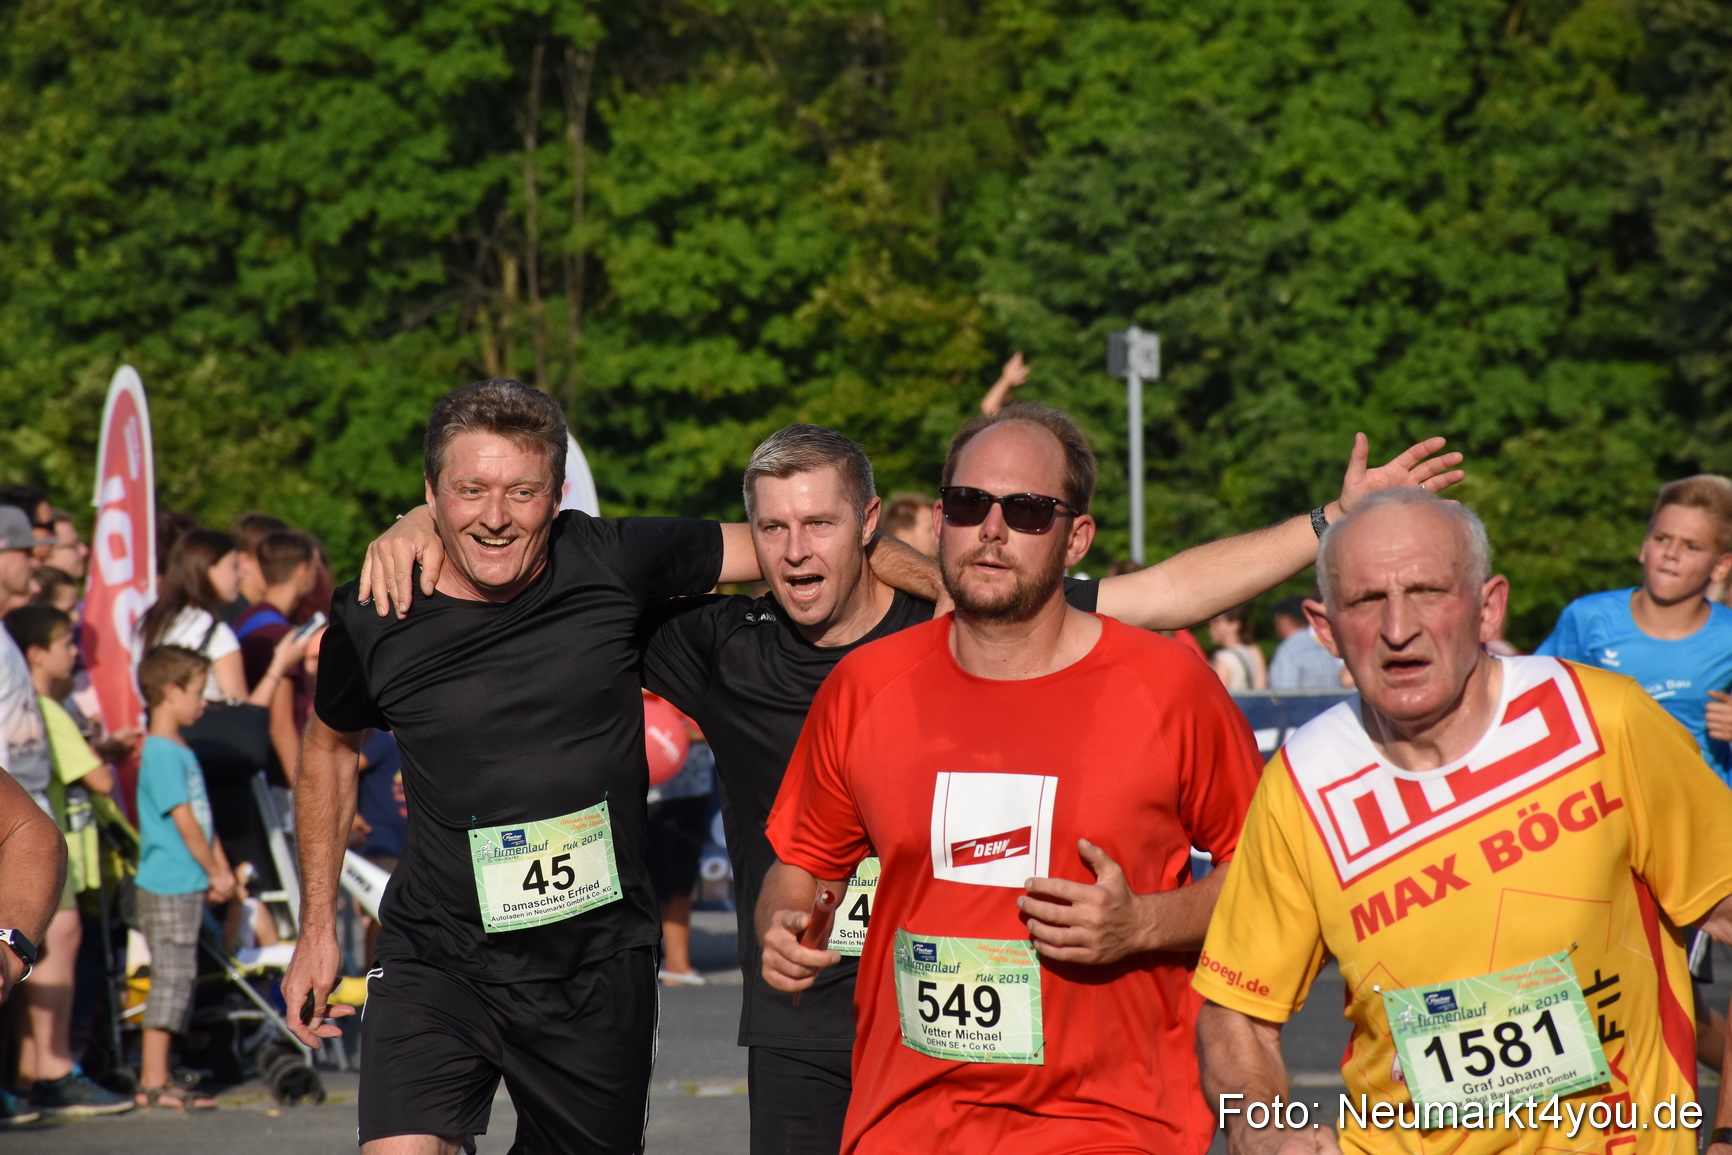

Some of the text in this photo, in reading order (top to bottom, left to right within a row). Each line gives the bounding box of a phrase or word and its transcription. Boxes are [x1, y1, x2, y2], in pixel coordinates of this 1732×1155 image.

[757, 612, 776, 622] AKO
[494, 840, 549, 858] firmenlauf
[562, 831, 604, 851] run 2019
[973, 838, 1010, 858] DEHN
[522, 853, 576, 896] 45
[1350, 781, 1624, 942] MAX BÖGL
[491, 913, 525, 922] Autoladen
[534, 904, 566, 915] Neumarkt
[566, 897, 586, 908] GmbH
[602, 886, 612, 894] KG
[503, 895, 566, 913] Damaschke
[568, 880, 600, 899] Erfried
[905, 956, 961, 974] firmenlauf
[975, 973, 1029, 984] run 2019
[1201, 951, 1269, 996] boegl.de
[918, 980, 1001, 1028] 549
[1417, 1002, 1487, 1029] firmenlauf
[1507, 990, 1569, 1016] run 2019
[921, 1024, 1002, 1041] Vetter Michael
[926, 1038, 947, 1048] DEHN
[949, 1041, 959, 1049] SE
[969, 1042, 981, 1051] Co
[983, 1043, 996, 1051] KG
[1424, 1010, 1565, 1083] 1581
[1462, 1079, 1492, 1096] Graf
[1498, 1065, 1552, 1087] Johann
[1490, 1081, 1544, 1100] Bauservice
[1546, 1070, 1578, 1085] GmbH
